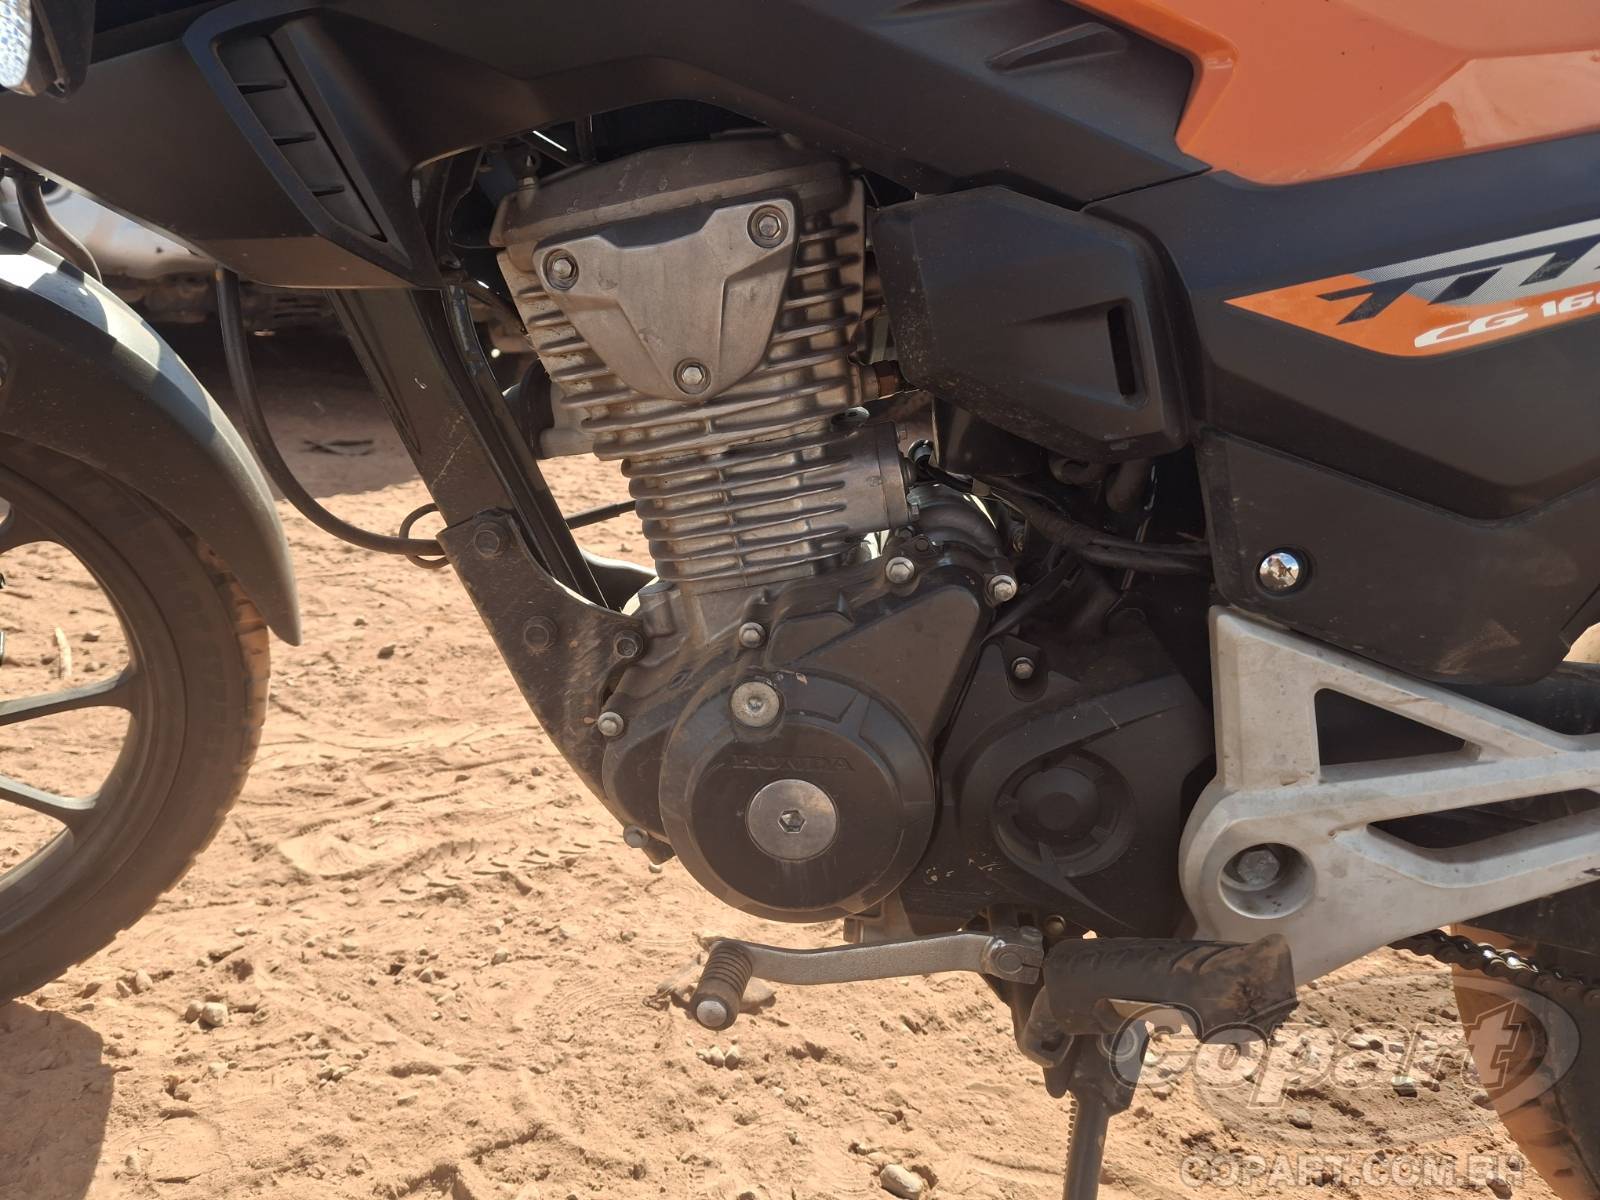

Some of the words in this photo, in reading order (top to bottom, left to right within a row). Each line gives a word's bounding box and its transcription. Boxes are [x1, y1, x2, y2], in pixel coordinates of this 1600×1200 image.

[1414, 308, 1529, 348] CG
[1541, 291, 1600, 317] 16
[732, 754, 856, 773] HONDA
